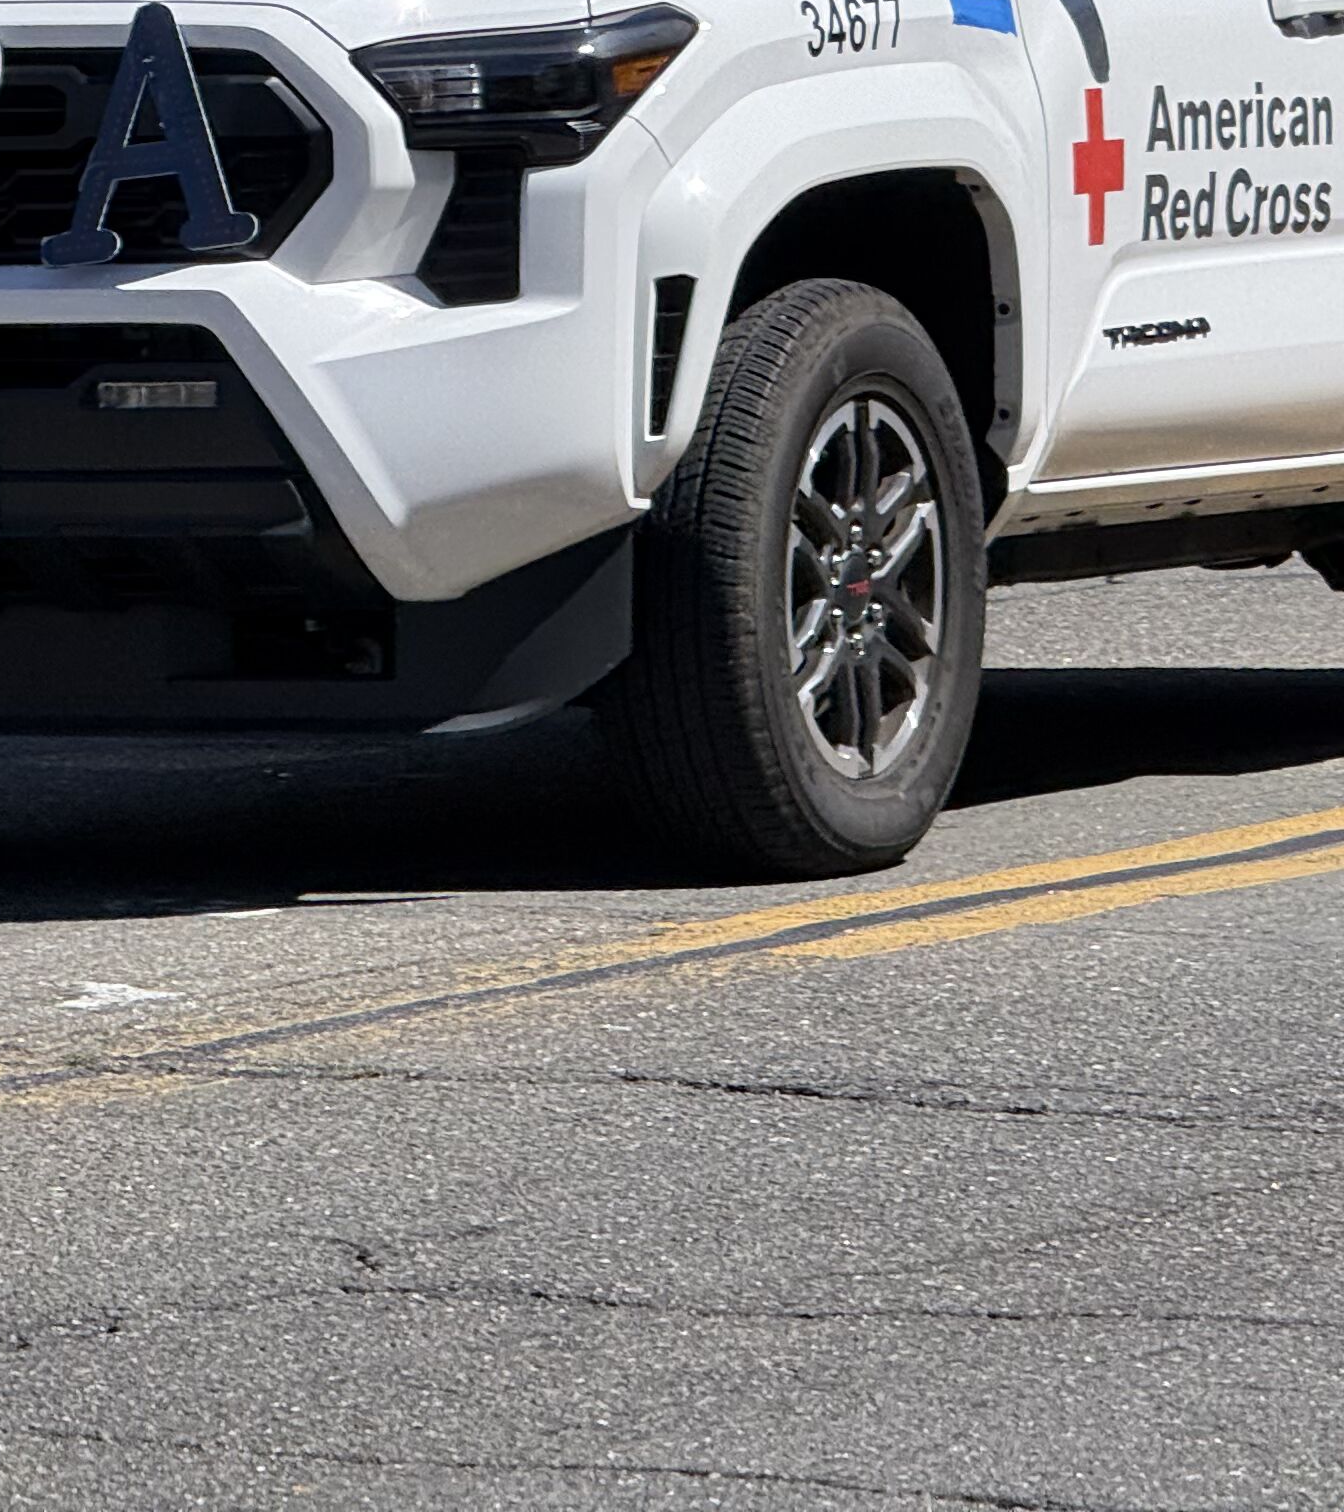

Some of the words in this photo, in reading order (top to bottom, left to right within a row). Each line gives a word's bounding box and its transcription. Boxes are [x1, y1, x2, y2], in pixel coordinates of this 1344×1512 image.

[1145, 81, 1334, 153] American
[1141, 171, 1217, 243] Red
[1224, 167, 1332, 239] Cross
